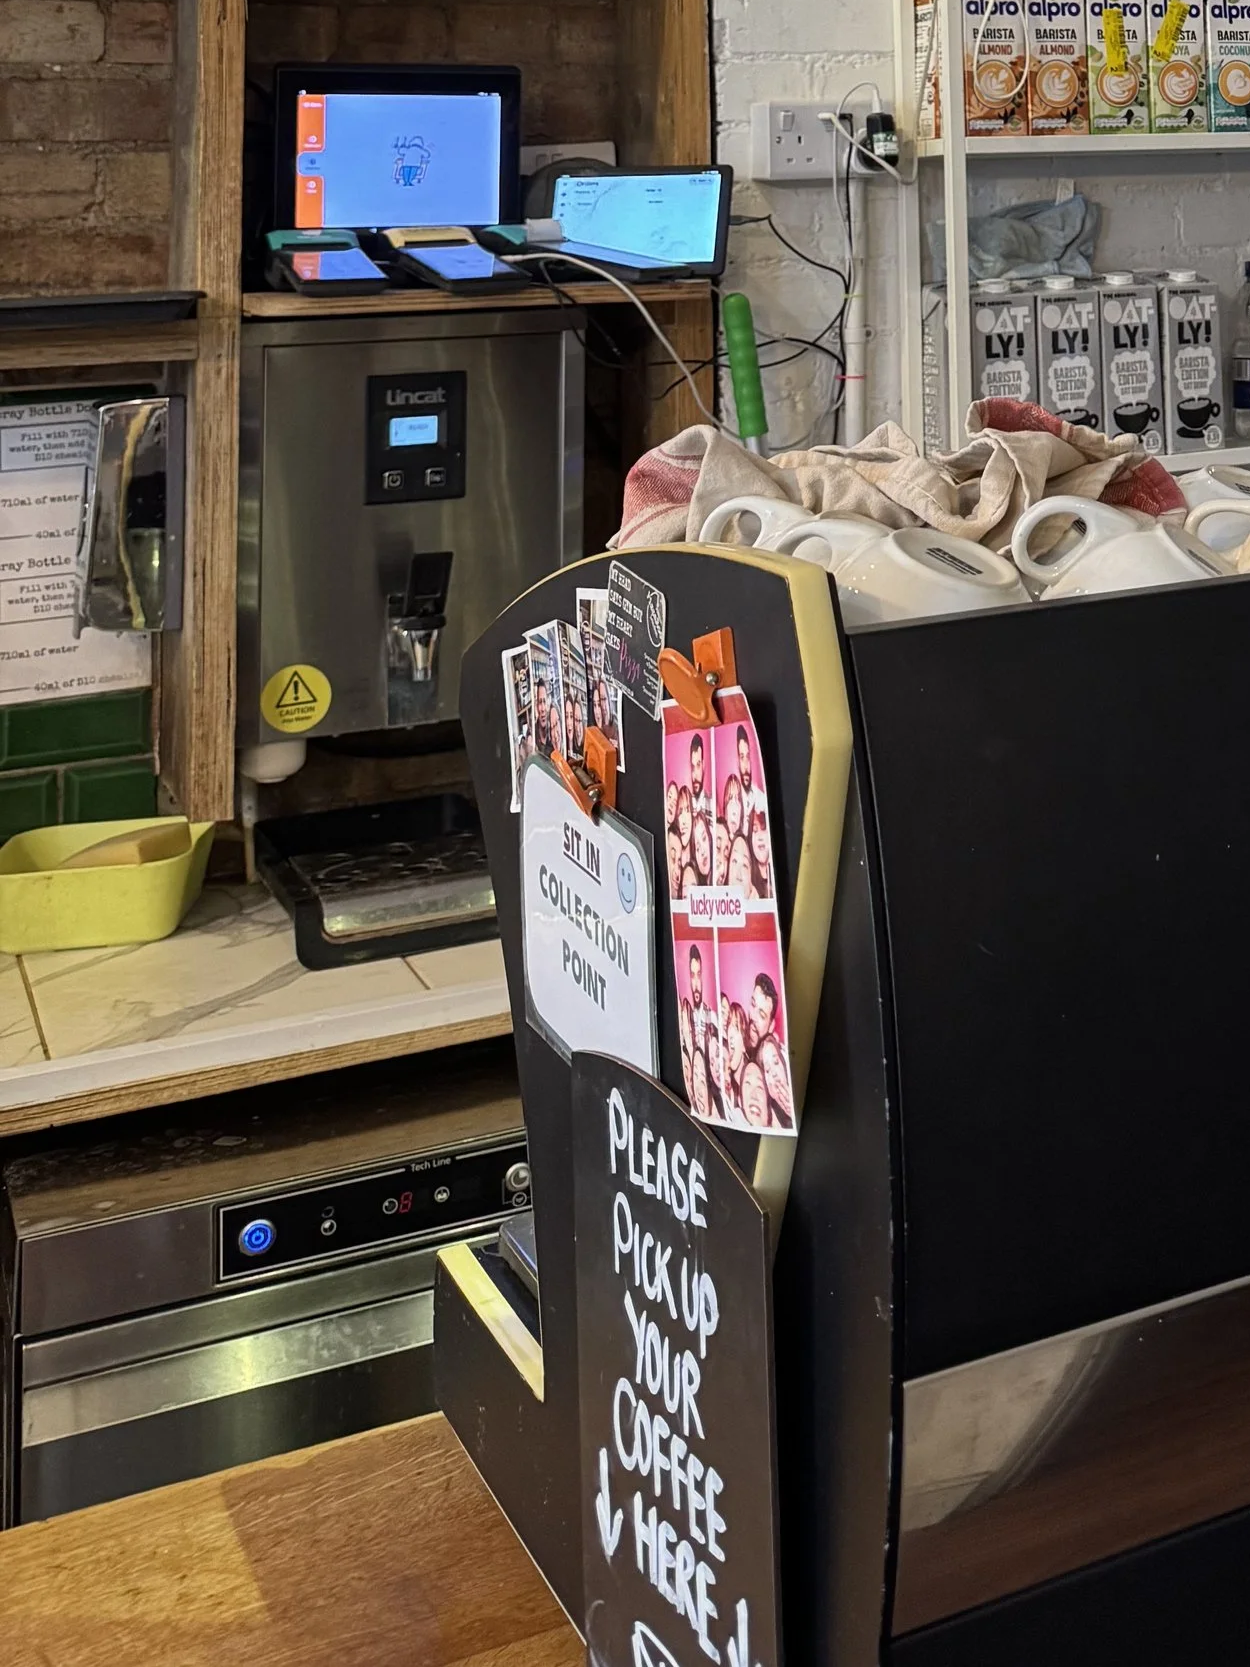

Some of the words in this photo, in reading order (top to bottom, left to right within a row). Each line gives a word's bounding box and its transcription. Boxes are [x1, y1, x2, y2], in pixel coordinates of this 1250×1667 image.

[973, 28, 1015, 40] BARISTA
[1035, 28, 1078, 40] BARISTA
[978, 44, 1013, 56] ALMOND
[1039, 44, 1075, 56] ALMOND
[1172, 45, 1190, 56] OYA
[1113, 323, 1150, 349] LY!
[1177, 319, 1212, 345] LY!
[985, 332, 1025, 359] LY!
[1051, 328, 1089, 354] LY!
[1115, 360, 1148, 373] BARISTA
[1178, 355, 1209, 368] BARISTA
[986, 370, 1022, 384] BARISTA
[1053, 365, 1087, 380] BARISTA
[1118, 372, 1148, 384] EDITION
[1181, 368, 1209, 381] EDITION
[988, 384, 1021, 396] EDITION
[1056, 380, 1087, 392] EDITION
[385, 387, 447, 406] Lincat
[29, 401, 73, 417] Bottle
[20, 432, 43, 442] Fill
[45, 429, 69, 439] with
[9, 443, 41, 453] water,
[42, 441, 65, 450] then
[1, 496, 32, 508] 710ml
[35, 494, 48, 505] of
[49, 494, 80, 503] water
[35, 529, 62, 539] 40ml
[27, 554, 72, 569] Bottle
[19, 583, 42, 594] Fill
[44, 581, 68, 591] with
[7, 596, 40, 606] water,
[41, 593, 65, 602] then
[616, 616, 633, 638] HEART
[605, 632, 621, 651] SAYS
[33, 647, 47, 657] of
[48, 644, 79, 655] water
[34, 680, 60, 691] 40ml
[62, 678, 76, 688] of
[279, 705, 316, 717] CAUTION
[563, 821, 581, 862] SIT
[586, 837, 601, 879] IN
[690, 892, 715, 922] lucky
[715, 891, 741, 916] voice
[539, 863, 629, 977] COLLECTION
[562, 938, 607, 1011] POINT
[606, 1086, 709, 1229] PLEASE
[410, 1161, 431, 1173] Tech
[432, 1157, 452, 1169] Line
[611, 1190, 678, 1320] PICK
[681, 1256, 720, 1360] UP
[623, 1289, 707, 1441] YOUR
[611, 1376, 727, 1563] COFFEE
[633, 1491, 721, 1666] HERE
